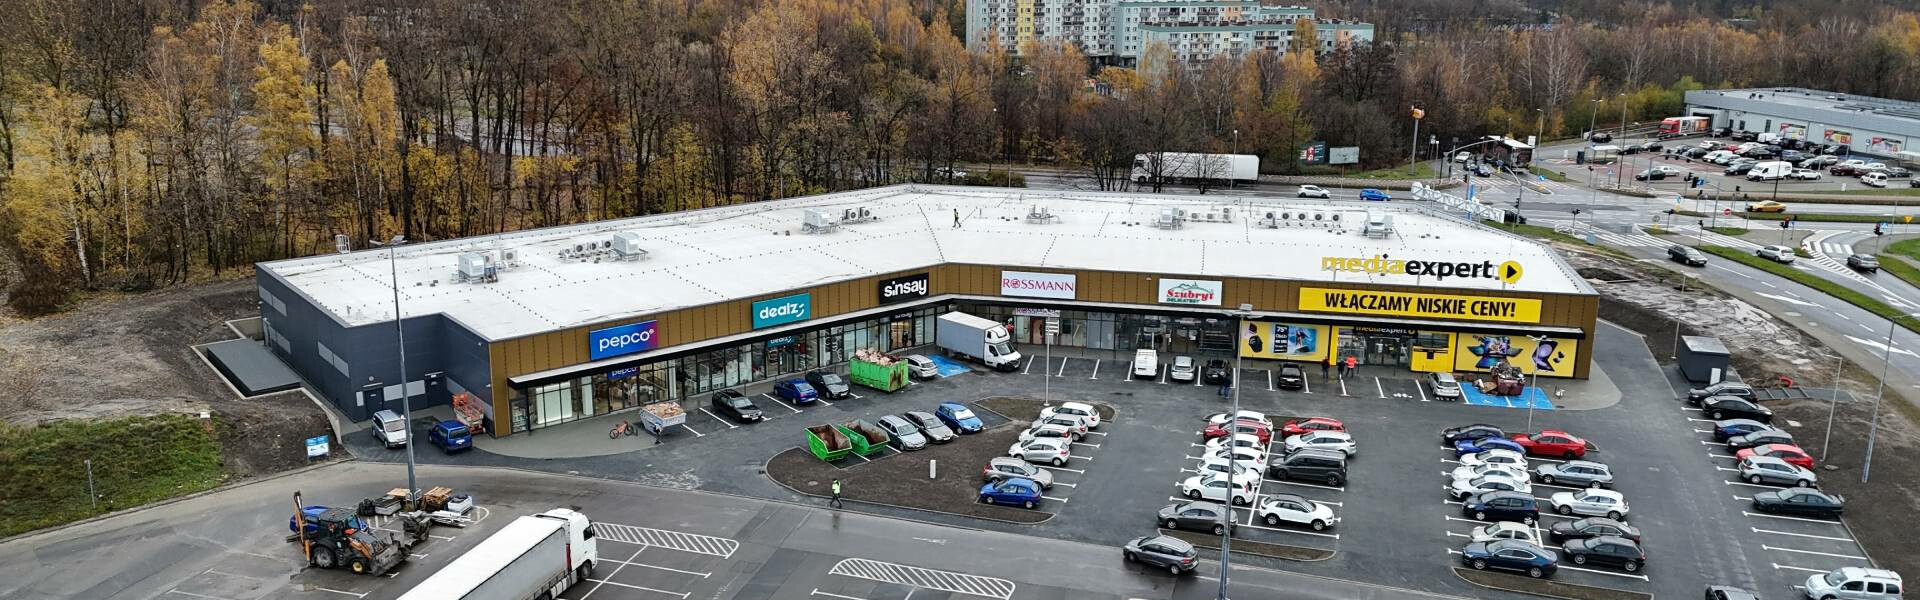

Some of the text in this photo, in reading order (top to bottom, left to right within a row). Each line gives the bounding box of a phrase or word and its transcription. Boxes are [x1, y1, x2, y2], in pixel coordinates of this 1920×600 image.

[1321, 253, 1492, 280] mediaexpert
[884, 279, 927, 298] sinsay
[1002, 278, 1074, 292] ROSSMANN
[1167, 288, 1214, 301] Szubryt
[759, 302, 800, 320] dealz
[1324, 292, 1516, 317] WŁĄCZAMY NISKIE CENY!
[599, 329, 650, 352] pepco
